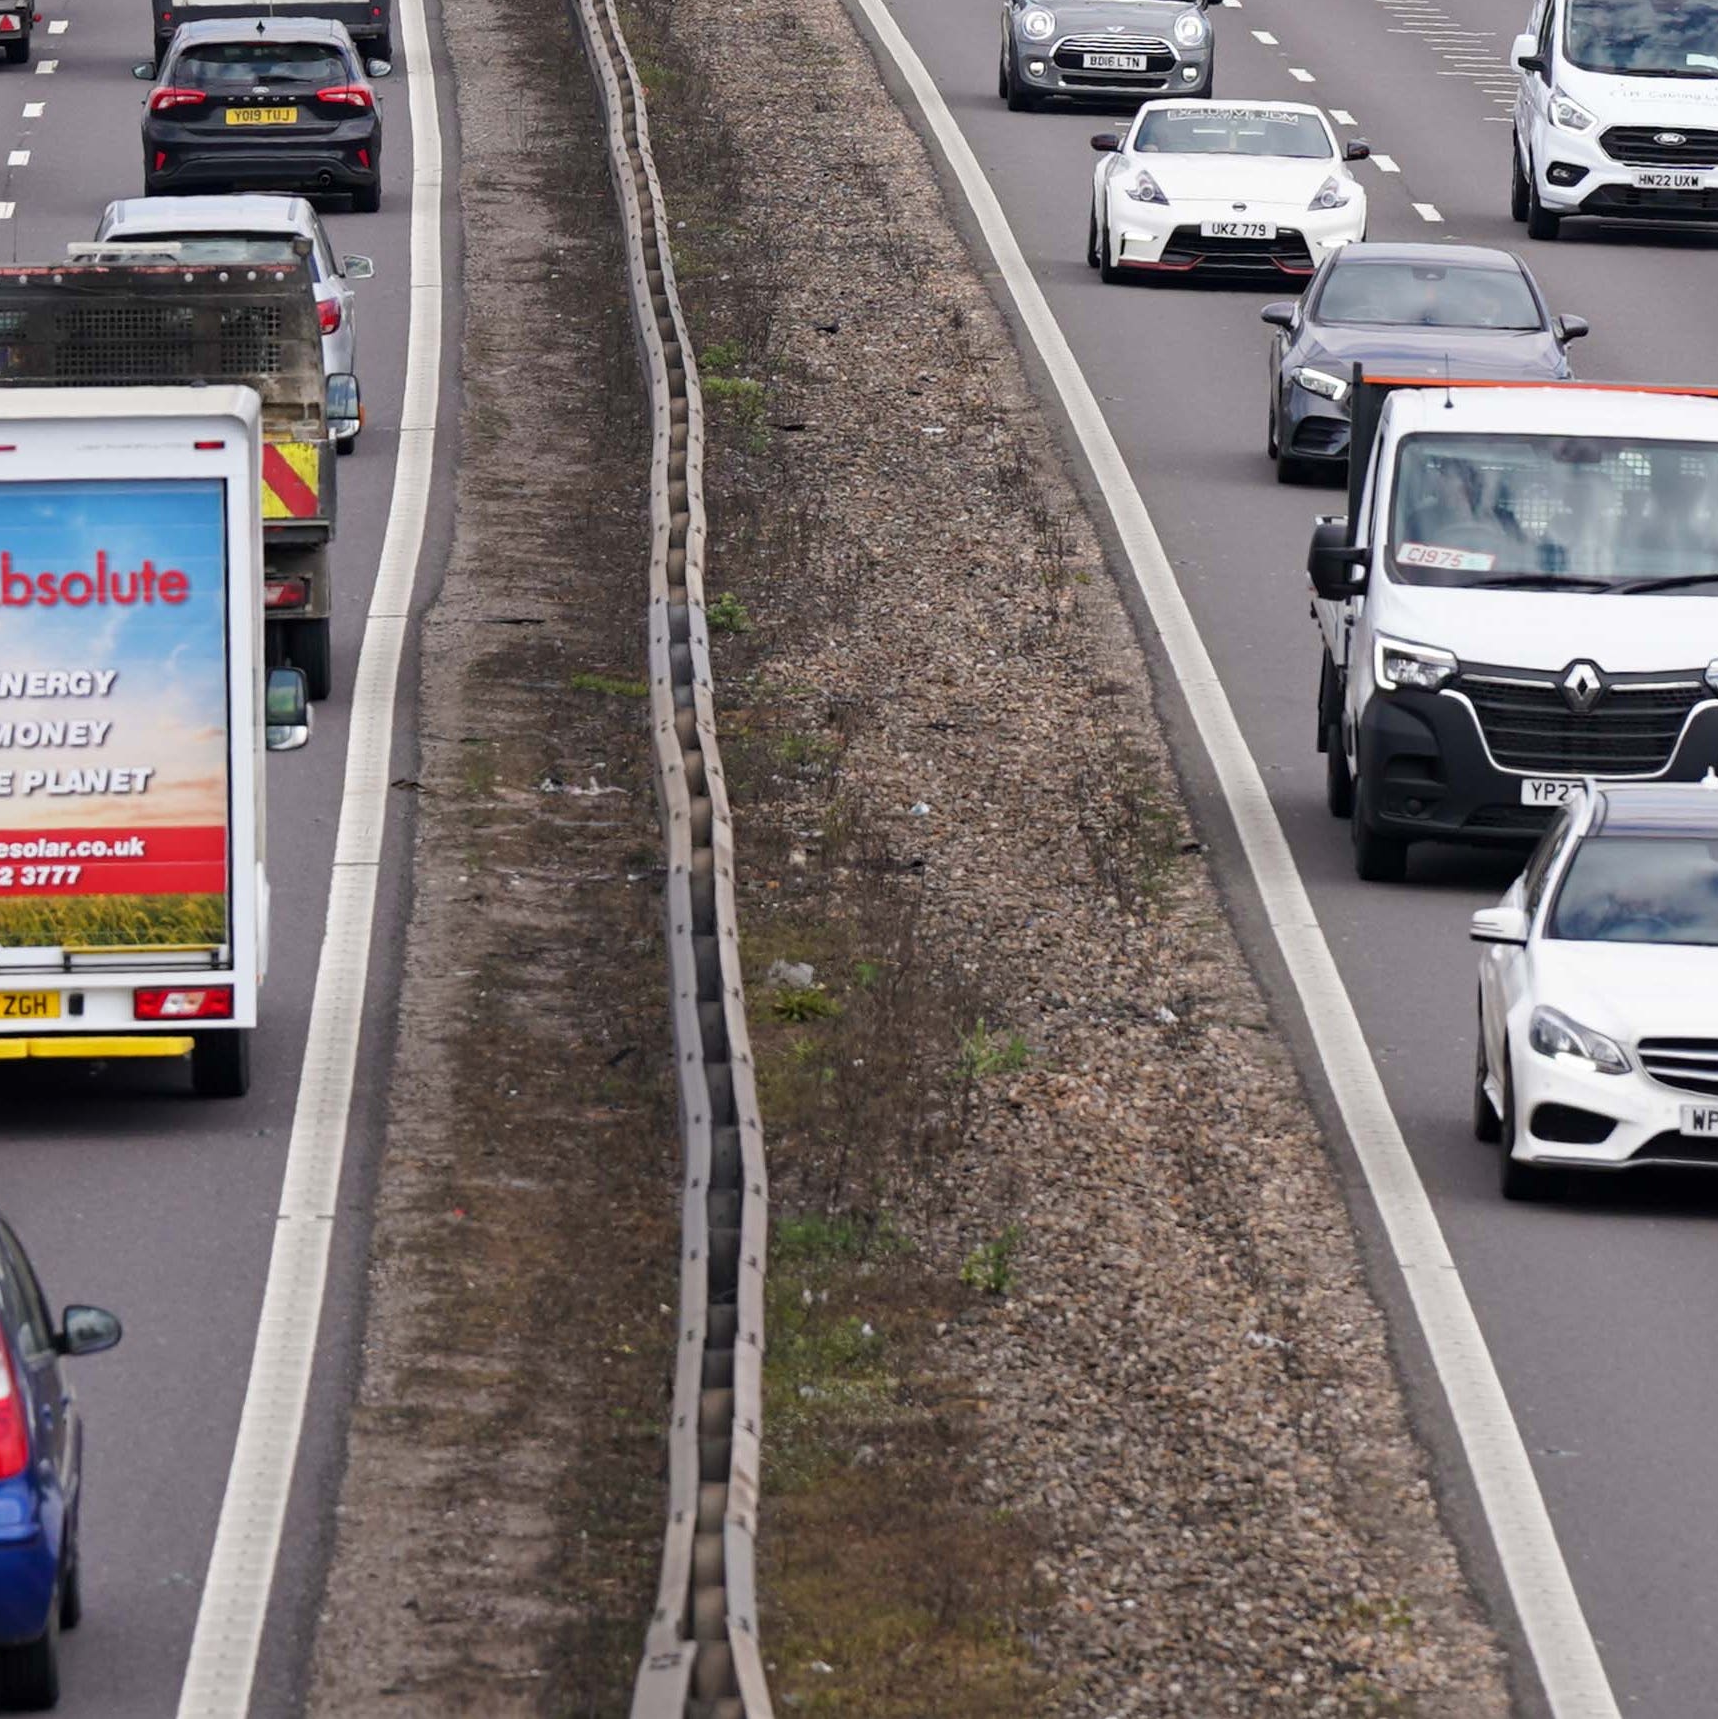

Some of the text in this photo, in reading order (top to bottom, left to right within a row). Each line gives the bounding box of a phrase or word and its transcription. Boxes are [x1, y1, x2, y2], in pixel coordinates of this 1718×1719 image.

[1253, 111, 1299, 123] JDM
[1638, 174, 1700, 187] HN22 UXW
[1212, 223, 1267, 237] UKZ 779
[1407, 547, 1462, 568] C1975
[21, 766, 154, 795] PLANET
[1531, 781, 1583, 802] YP2
[19, 864, 81, 887] 3777
[2, 993, 47, 1015] ZGH
